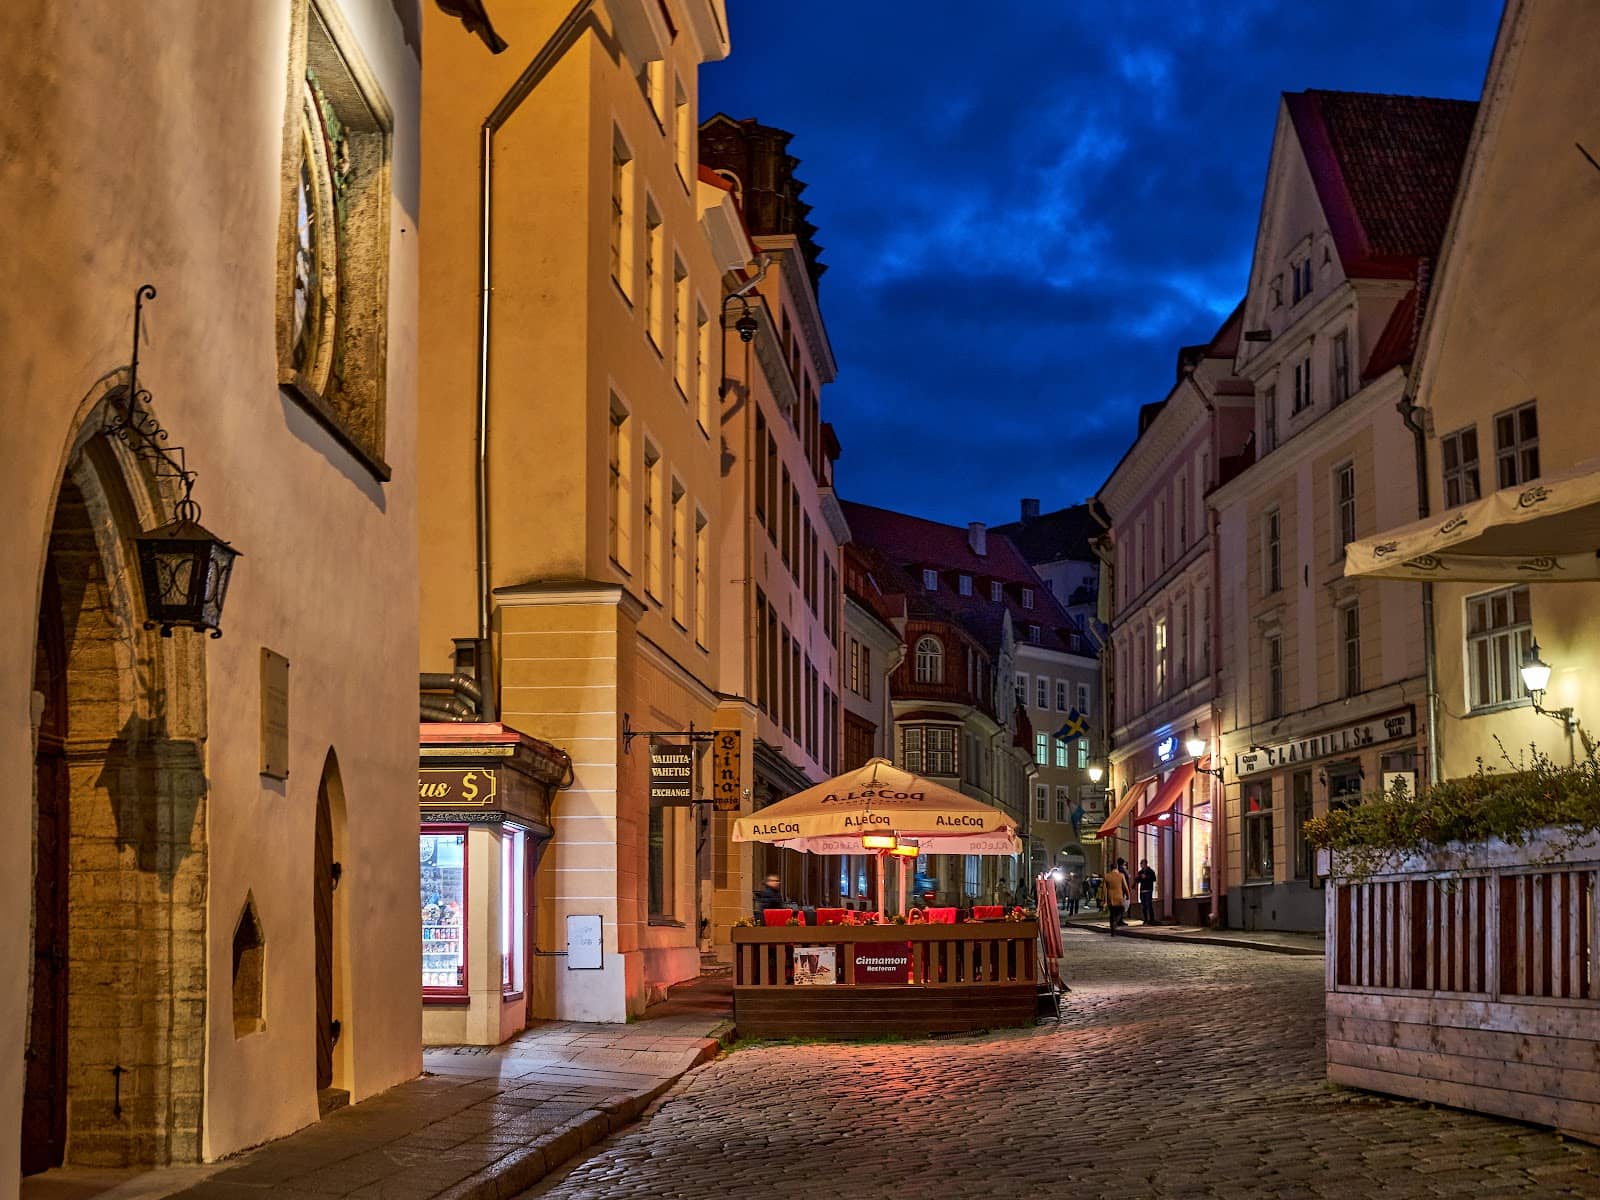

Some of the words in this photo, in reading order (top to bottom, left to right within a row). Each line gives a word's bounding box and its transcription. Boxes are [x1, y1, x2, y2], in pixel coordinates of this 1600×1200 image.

[1268, 728, 1361, 766] CLAYHILLS
[651, 767, 691, 777] VAHETUS
[651, 788, 691, 797] EXCHANGE
[855, 956, 908, 965] Cinnamon
